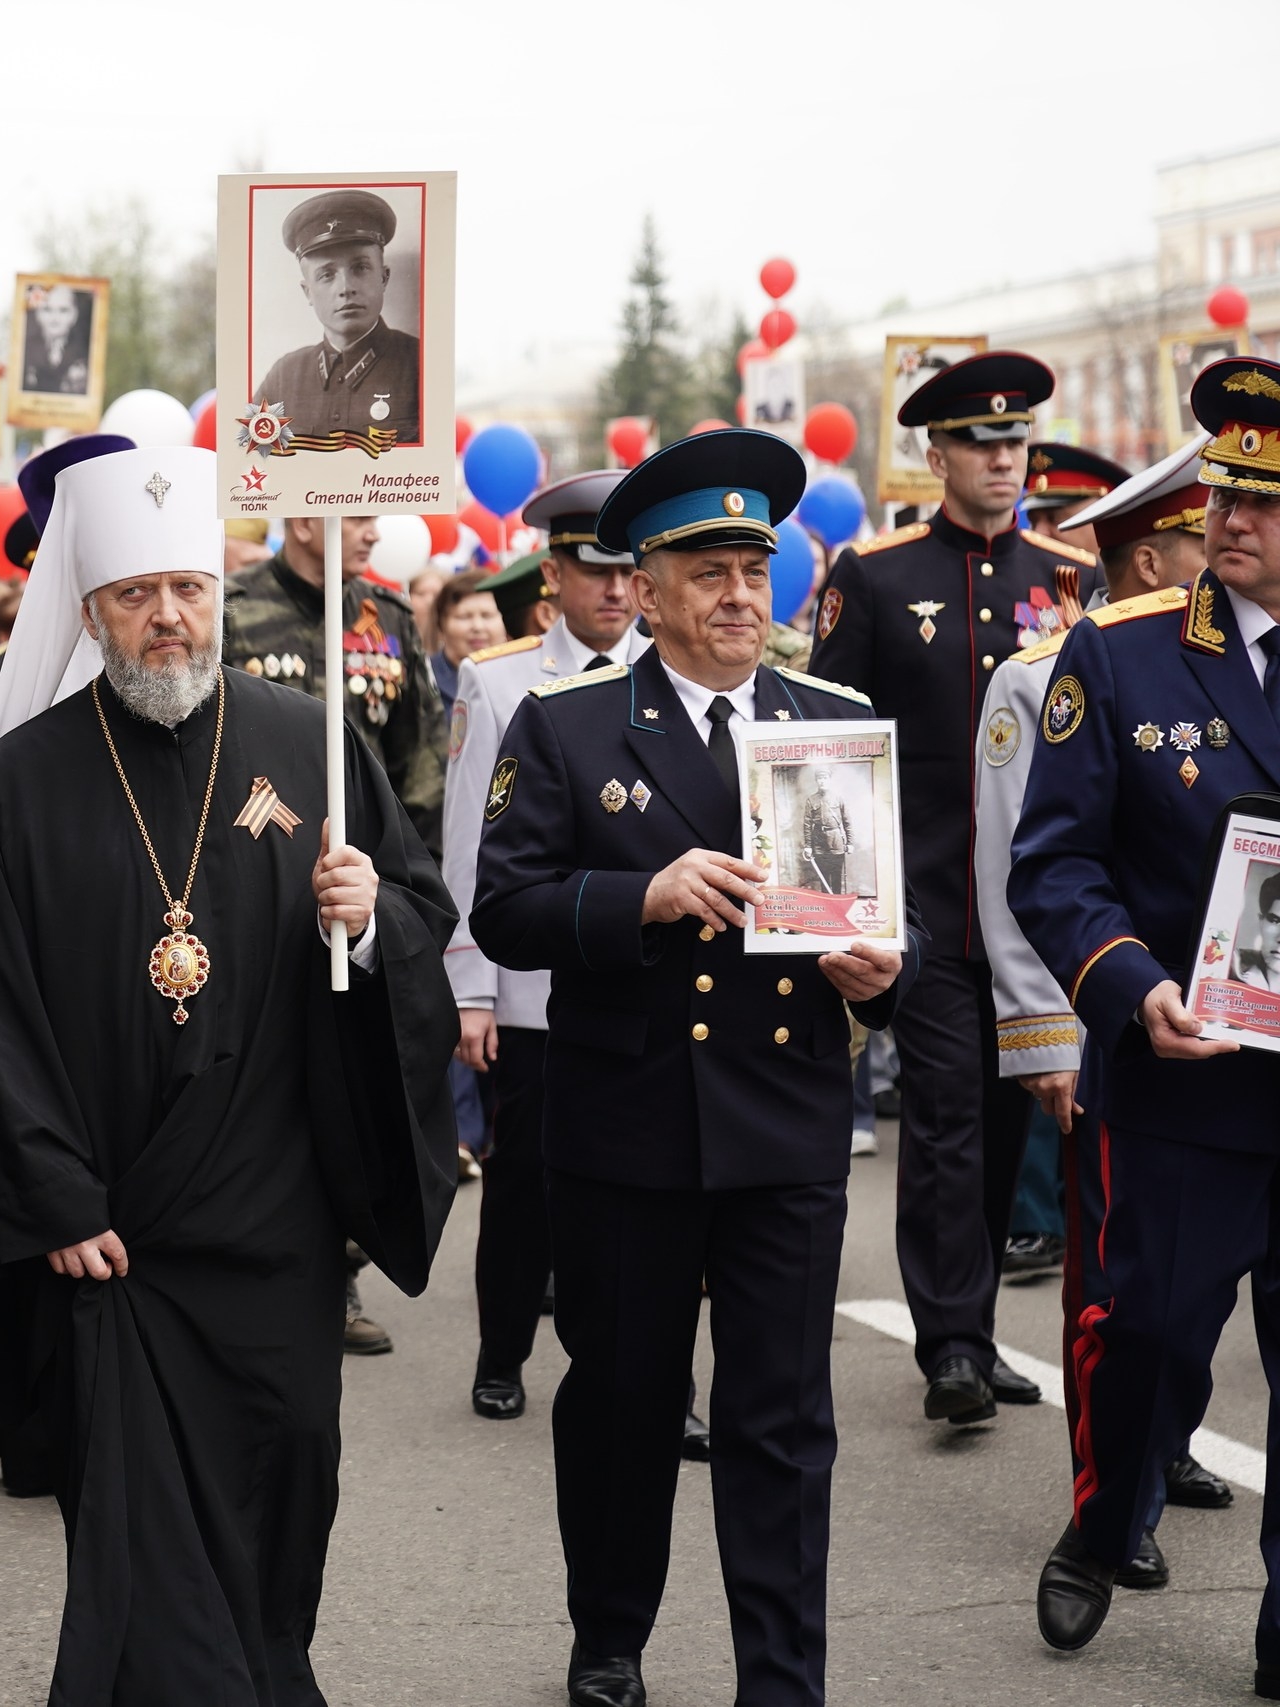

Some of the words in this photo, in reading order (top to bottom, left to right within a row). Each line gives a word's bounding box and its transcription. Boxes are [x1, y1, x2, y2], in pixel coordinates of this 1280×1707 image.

[362, 473, 440, 489] Малафеев
[305, 491, 363, 505] Степан
[367, 490, 440, 504] Иванович
[754, 741, 845, 761] БЕССМЕРТНЫЙ
[848, 740, 885, 757] ПОЛК
[1234, 999, 1279, 1011] Петрович
